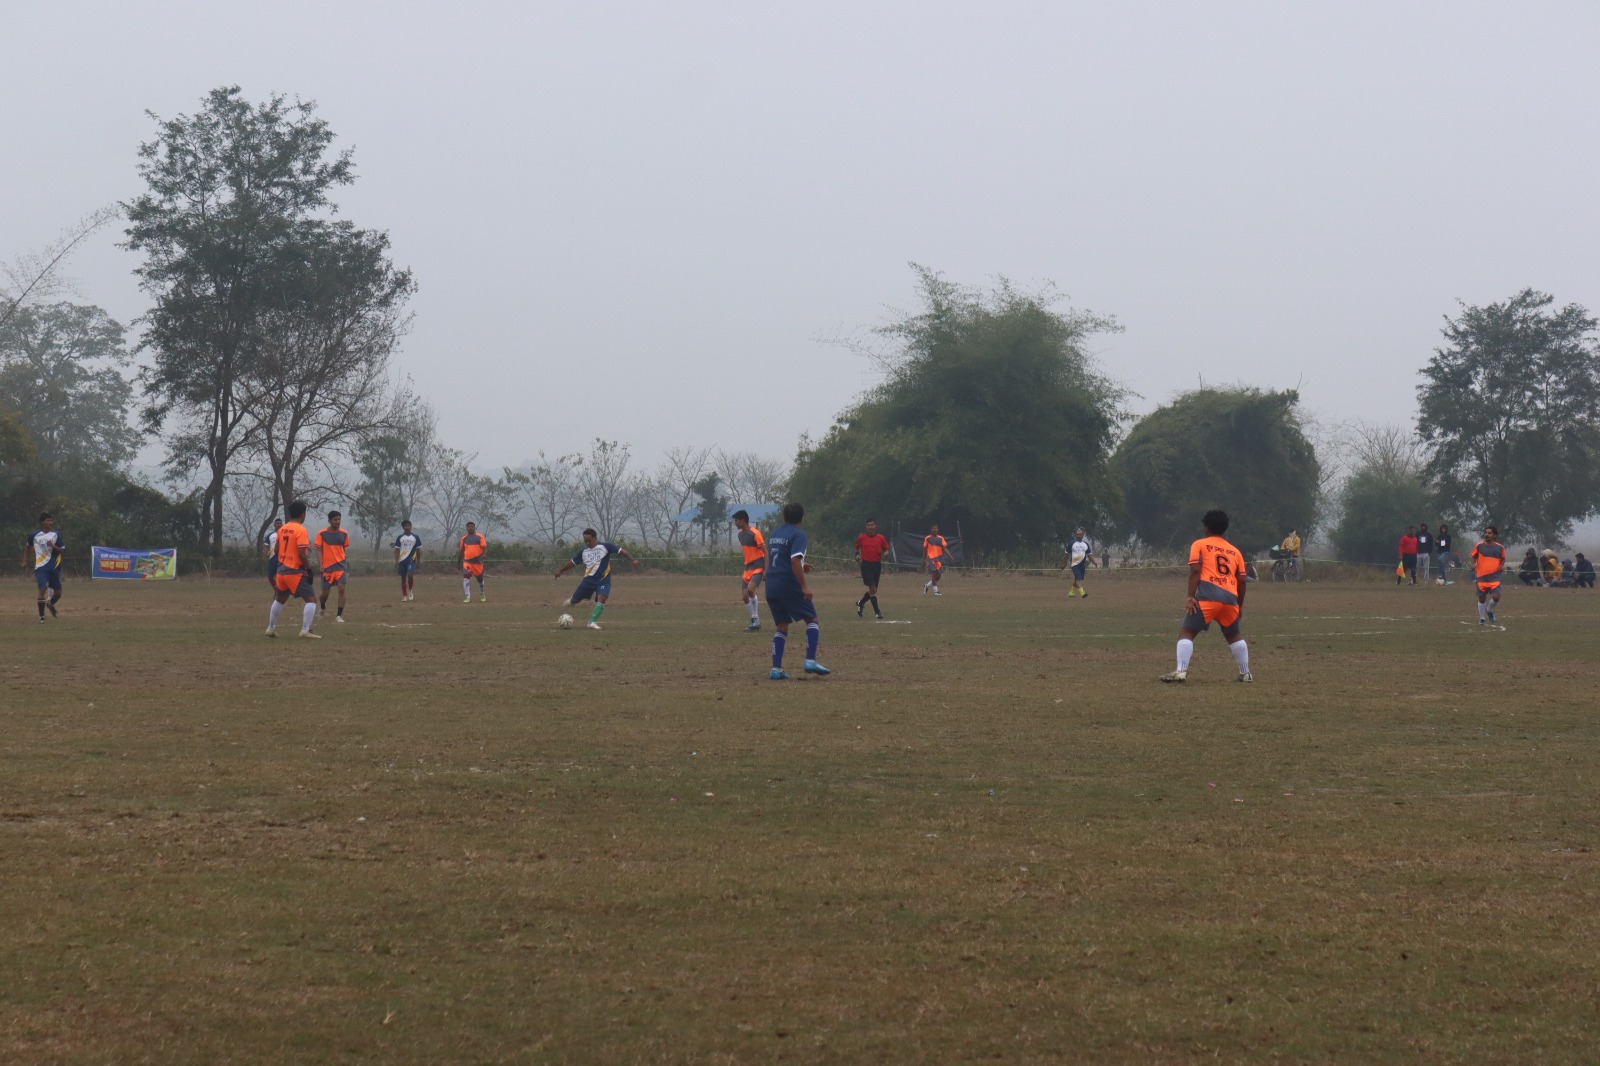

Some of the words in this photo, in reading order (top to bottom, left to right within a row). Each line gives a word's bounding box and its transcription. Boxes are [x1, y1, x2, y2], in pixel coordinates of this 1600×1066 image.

[283, 536, 289, 552] 7
[770, 547, 779, 567] 7
[1216, 554, 1230, 576] 6
